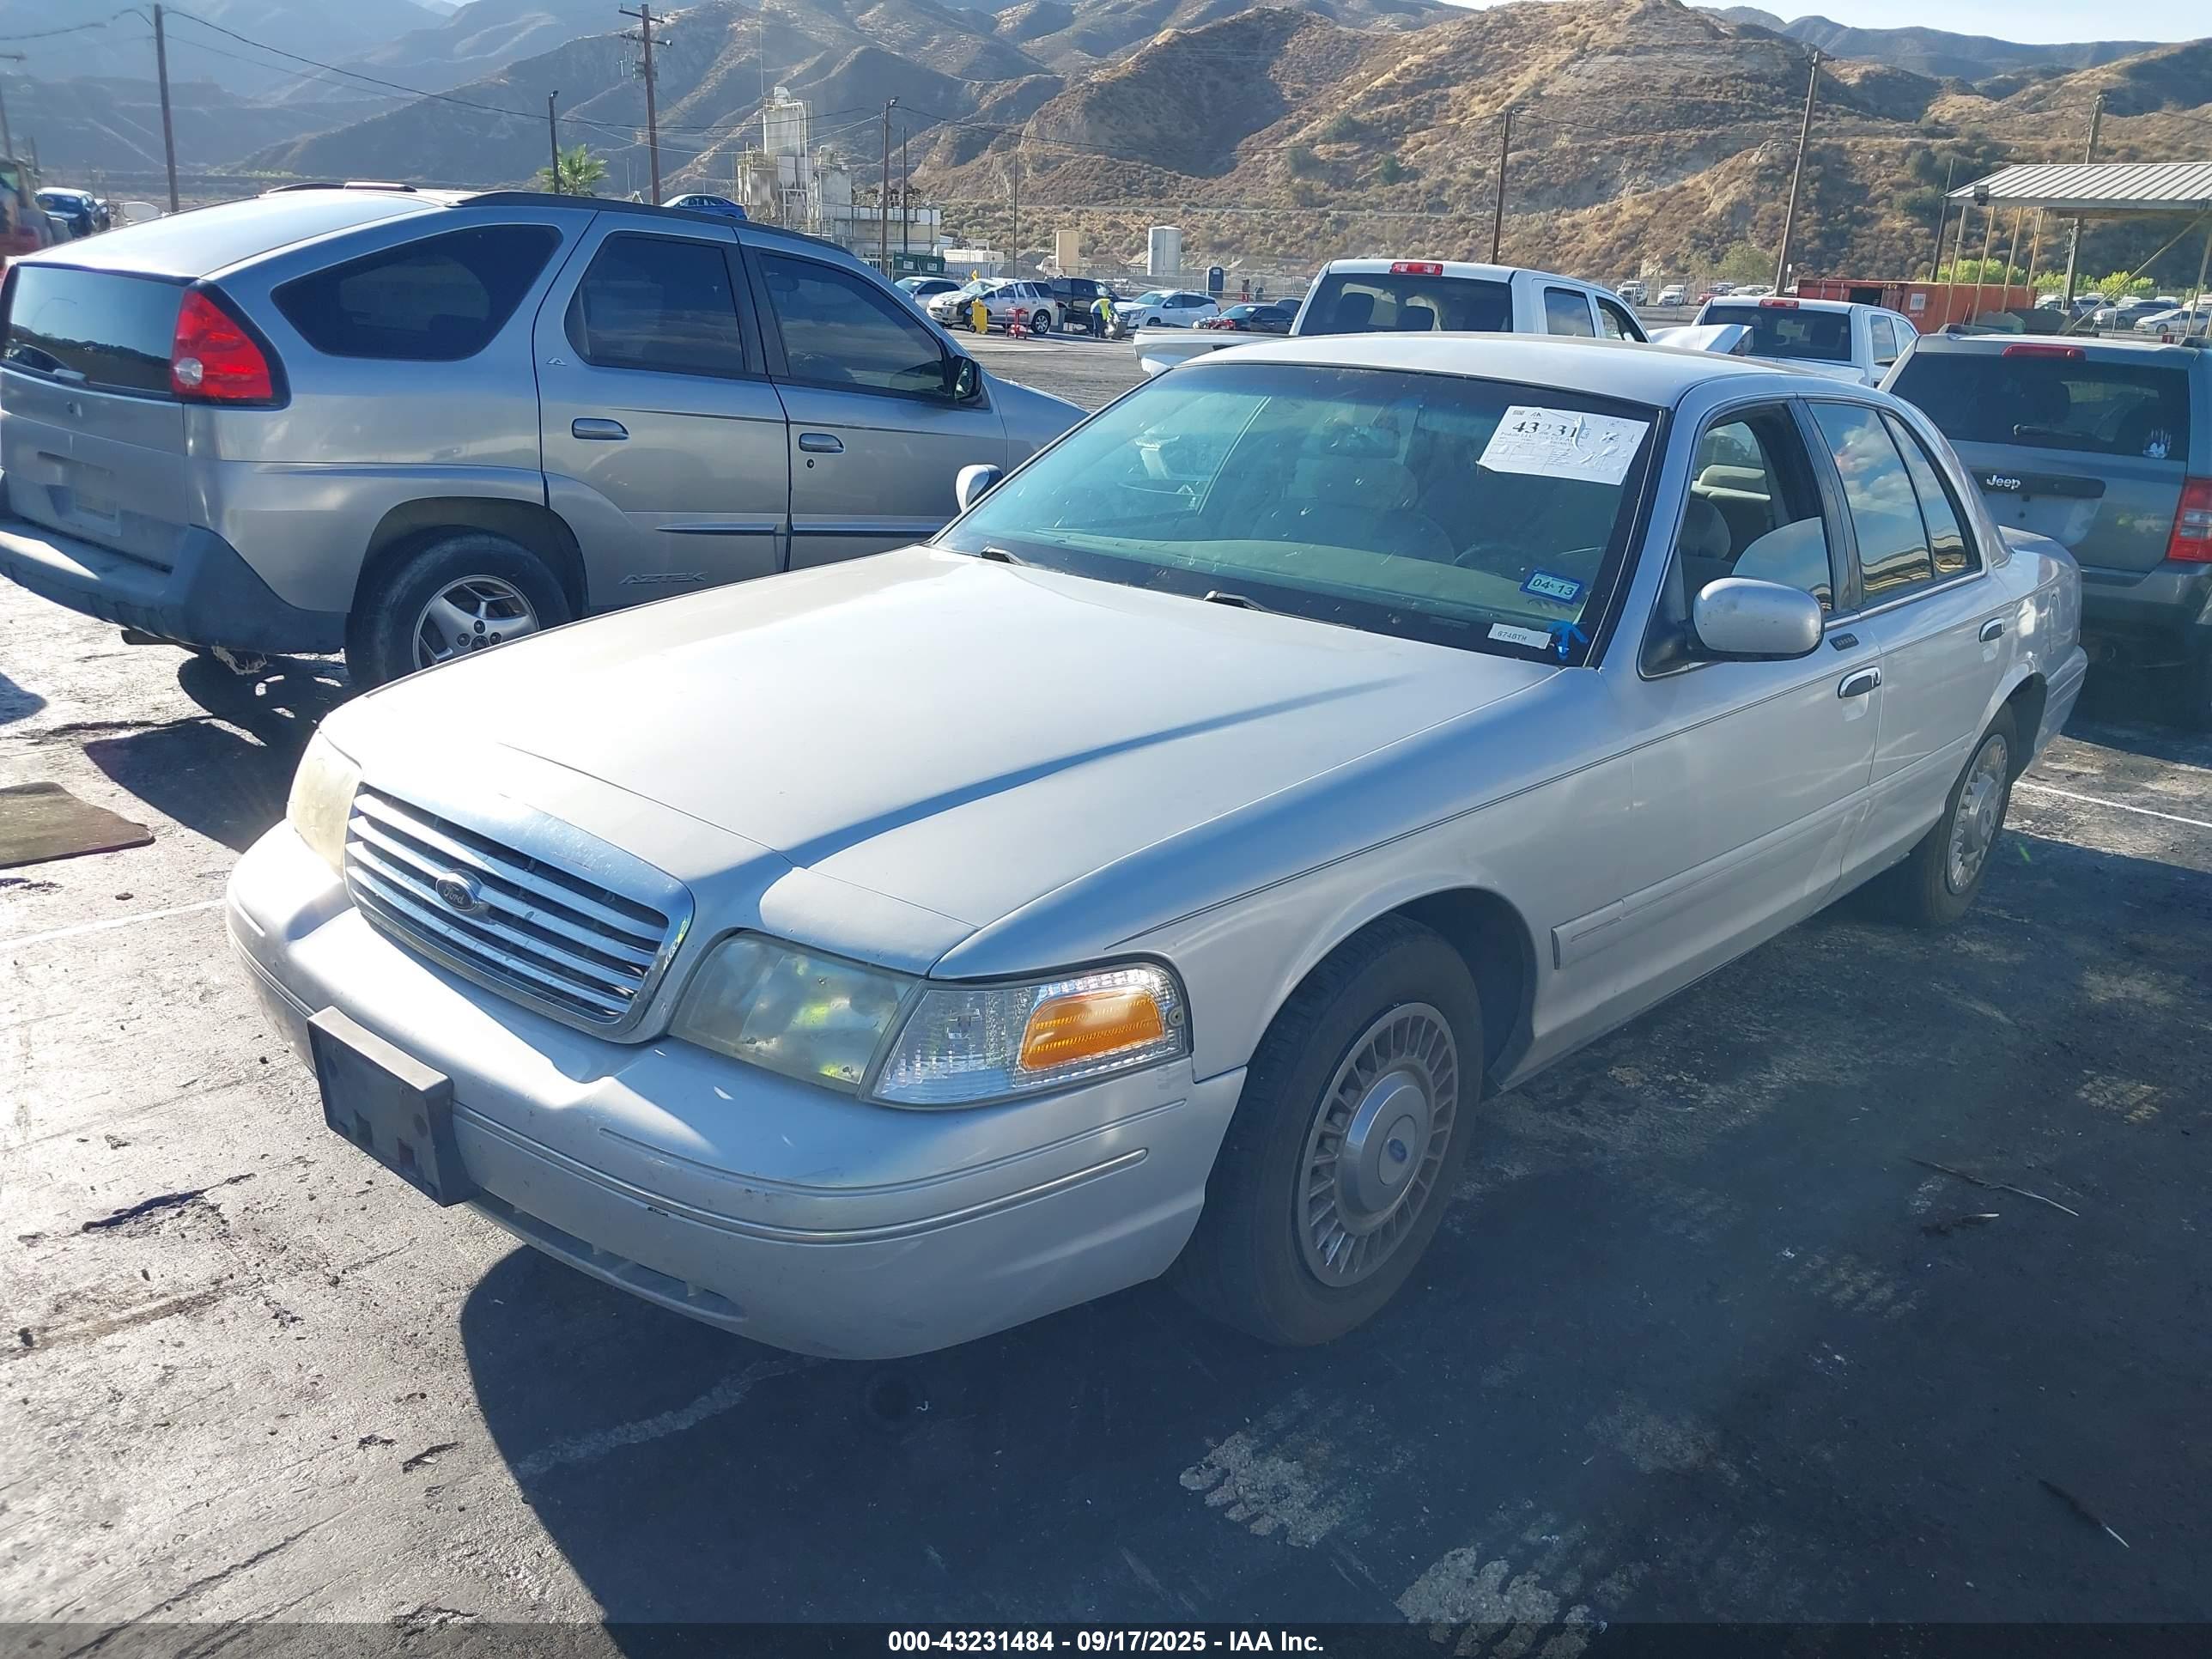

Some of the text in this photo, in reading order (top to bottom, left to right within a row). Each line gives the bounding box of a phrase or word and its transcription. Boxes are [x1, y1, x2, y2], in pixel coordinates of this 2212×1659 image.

[1986, 474, 2022, 490] Jeep
[618, 571, 708, 585] AZTEK
[1532, 578, 1575, 596] 04 13
[442, 883, 465, 905] Ford
